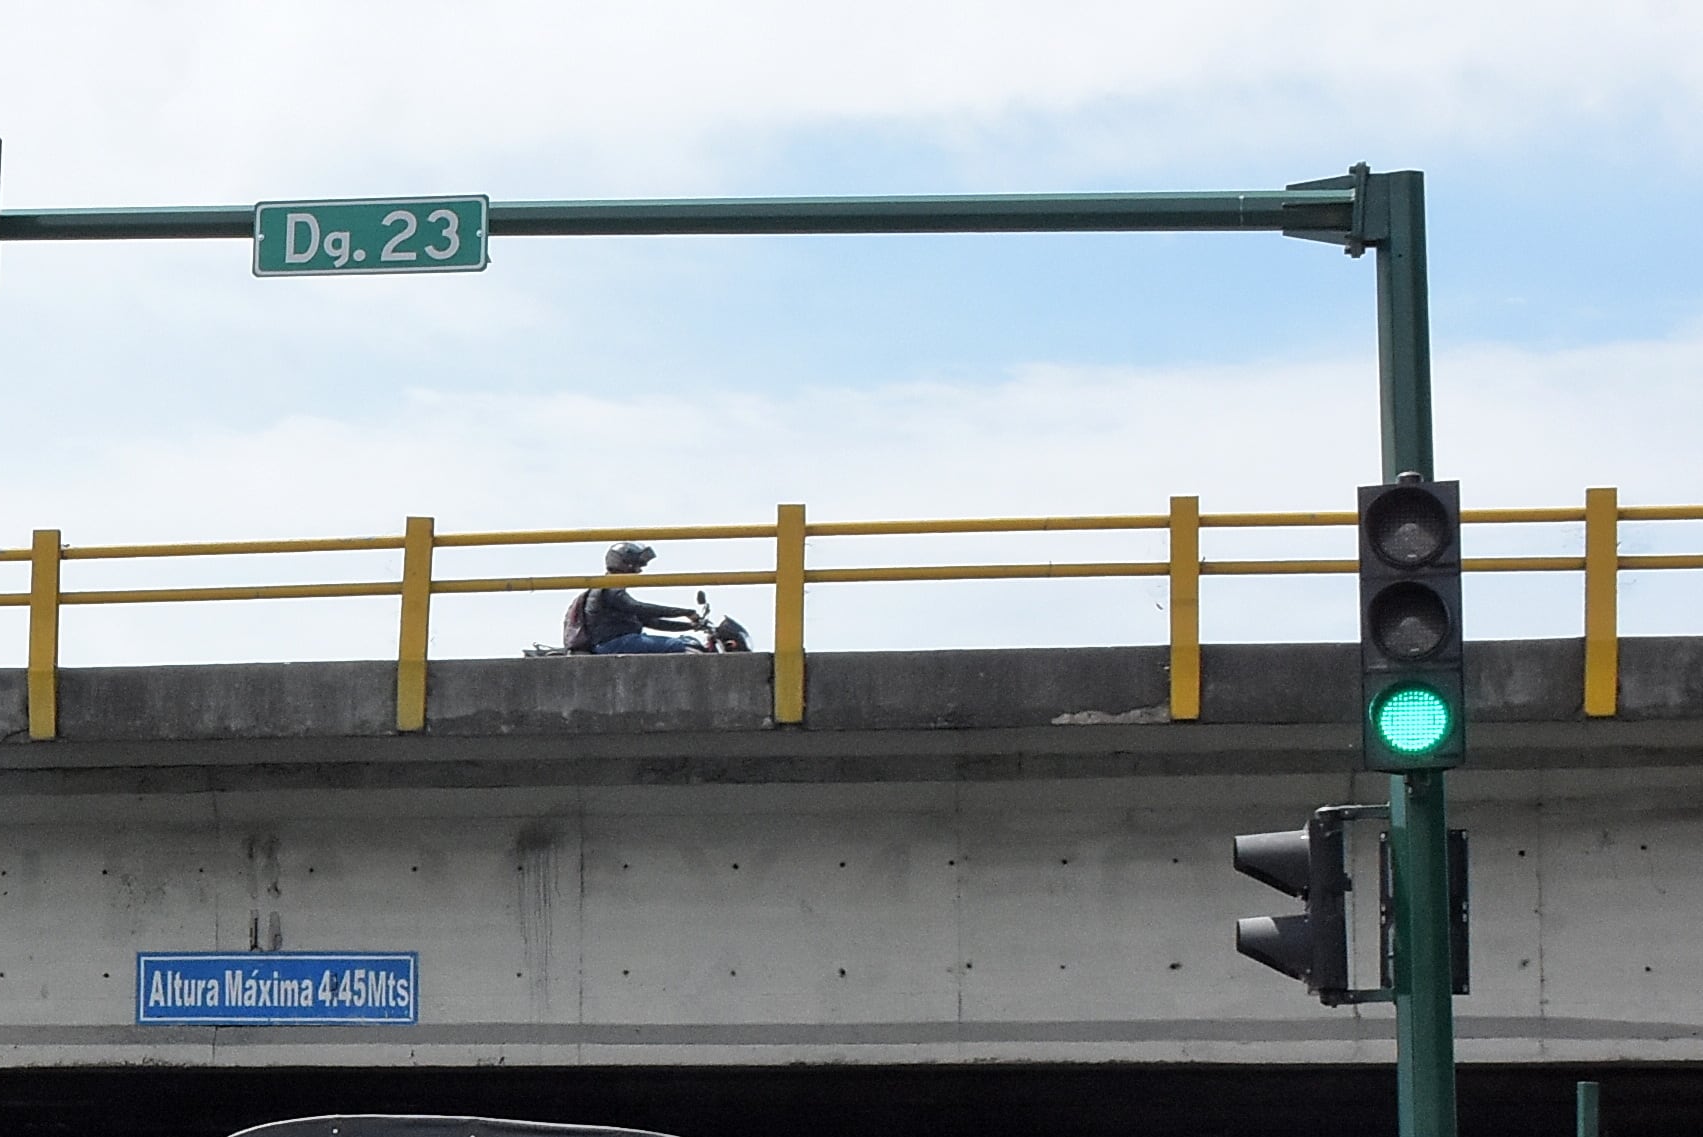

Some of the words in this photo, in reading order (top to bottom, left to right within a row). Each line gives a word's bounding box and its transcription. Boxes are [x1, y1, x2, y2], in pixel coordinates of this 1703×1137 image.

[284, 212, 367, 268] Dg.
[380, 208, 461, 262] 23
[148, 968, 220, 1008] Altura
[224, 968, 314, 1008] Máxima
